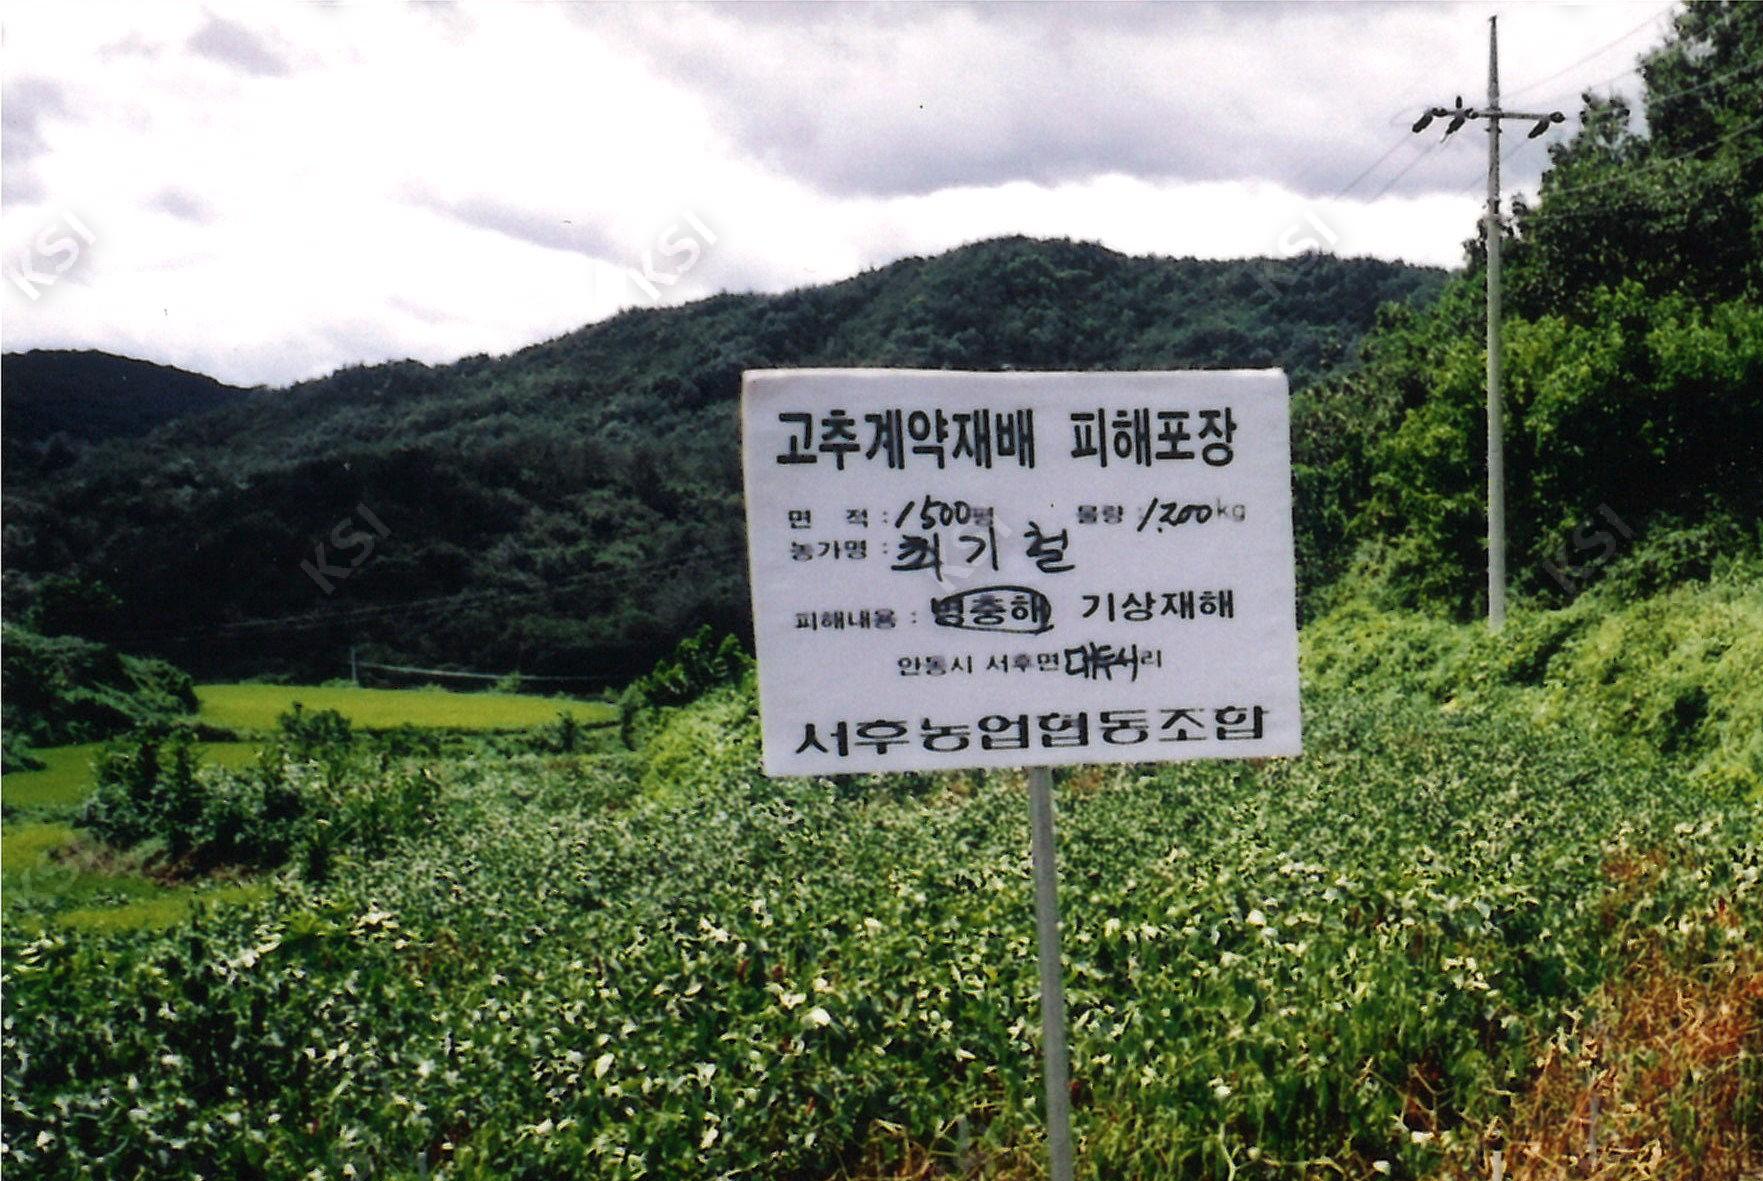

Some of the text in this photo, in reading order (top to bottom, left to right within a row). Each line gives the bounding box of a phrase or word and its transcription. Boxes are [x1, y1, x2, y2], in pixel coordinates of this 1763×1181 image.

[776, 407, 1238, 470] 고추계약재배 피해포장
[1082, 590, 1235, 622] 기상재해
[795, 704, 1268, 757] 서후농업협동조합
